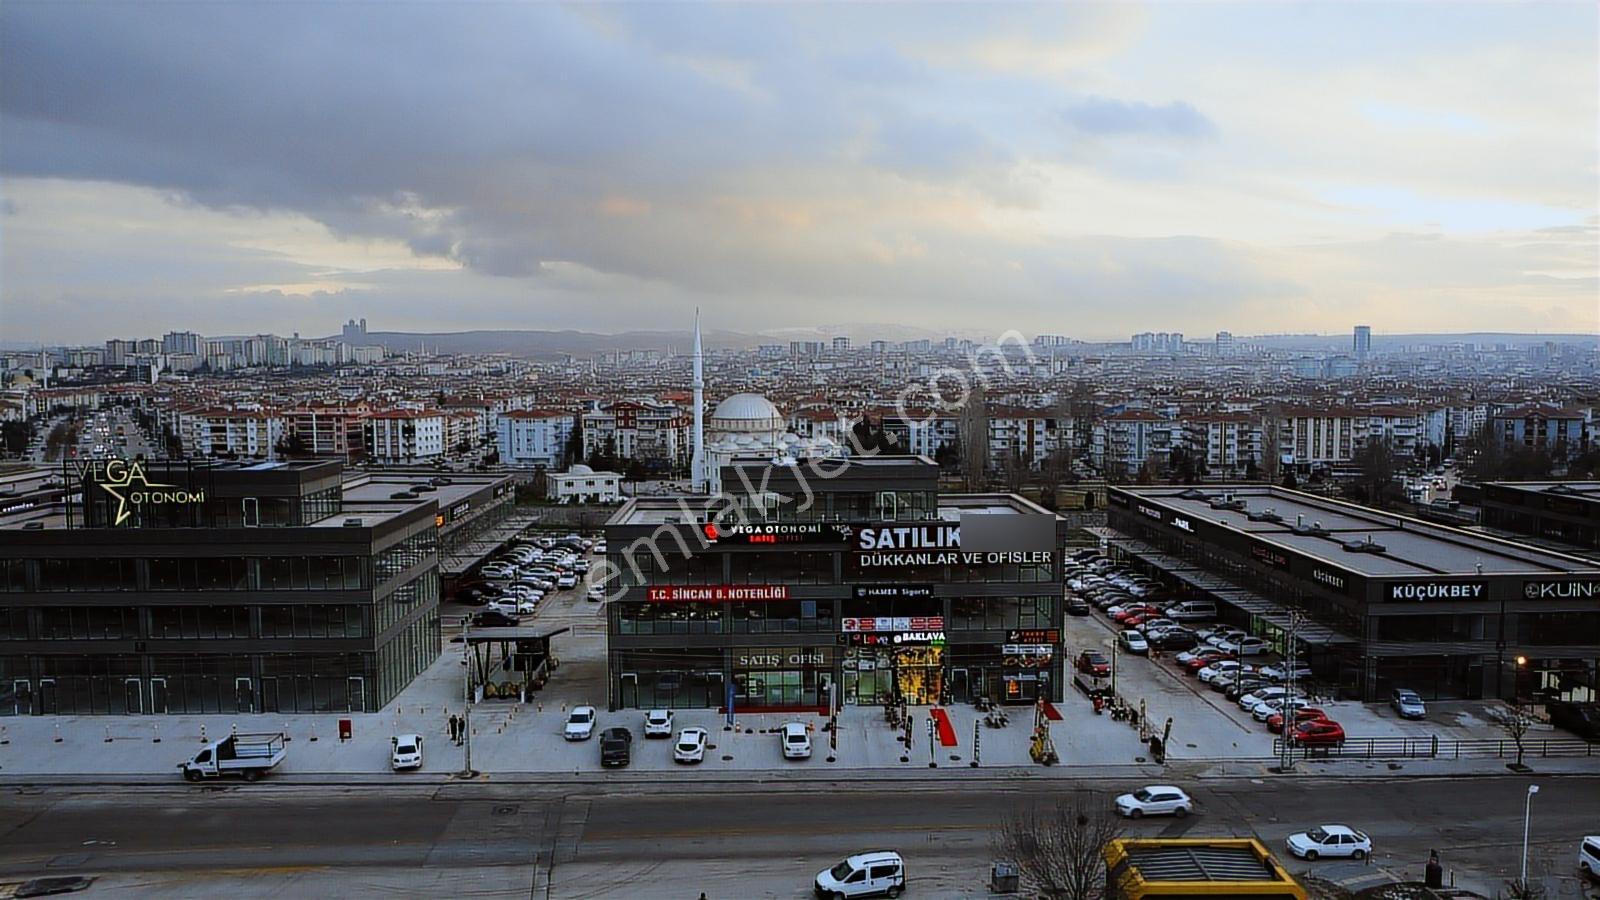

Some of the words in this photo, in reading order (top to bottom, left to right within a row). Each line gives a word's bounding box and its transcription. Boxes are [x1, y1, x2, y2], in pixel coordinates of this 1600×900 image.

[73, 460, 147, 483] VEGA
[130, 488, 205, 504] OTONOMİ
[731, 525, 762, 534] VEGA
[765, 523, 822, 533] OTONOMİ
[859, 526, 960, 549] SATILIK
[861, 551, 958, 566] DÜKKANLAR
[962, 552, 983, 564] VE
[651, 589, 670, 599] T.C.
[672, 587, 712, 599] SİNCAN
[728, 586, 786, 599] NOTERLİĞİ
[1393, 583, 1482, 600] KÜÇÜKBEY
[740, 654, 780, 666] SATIŞ
